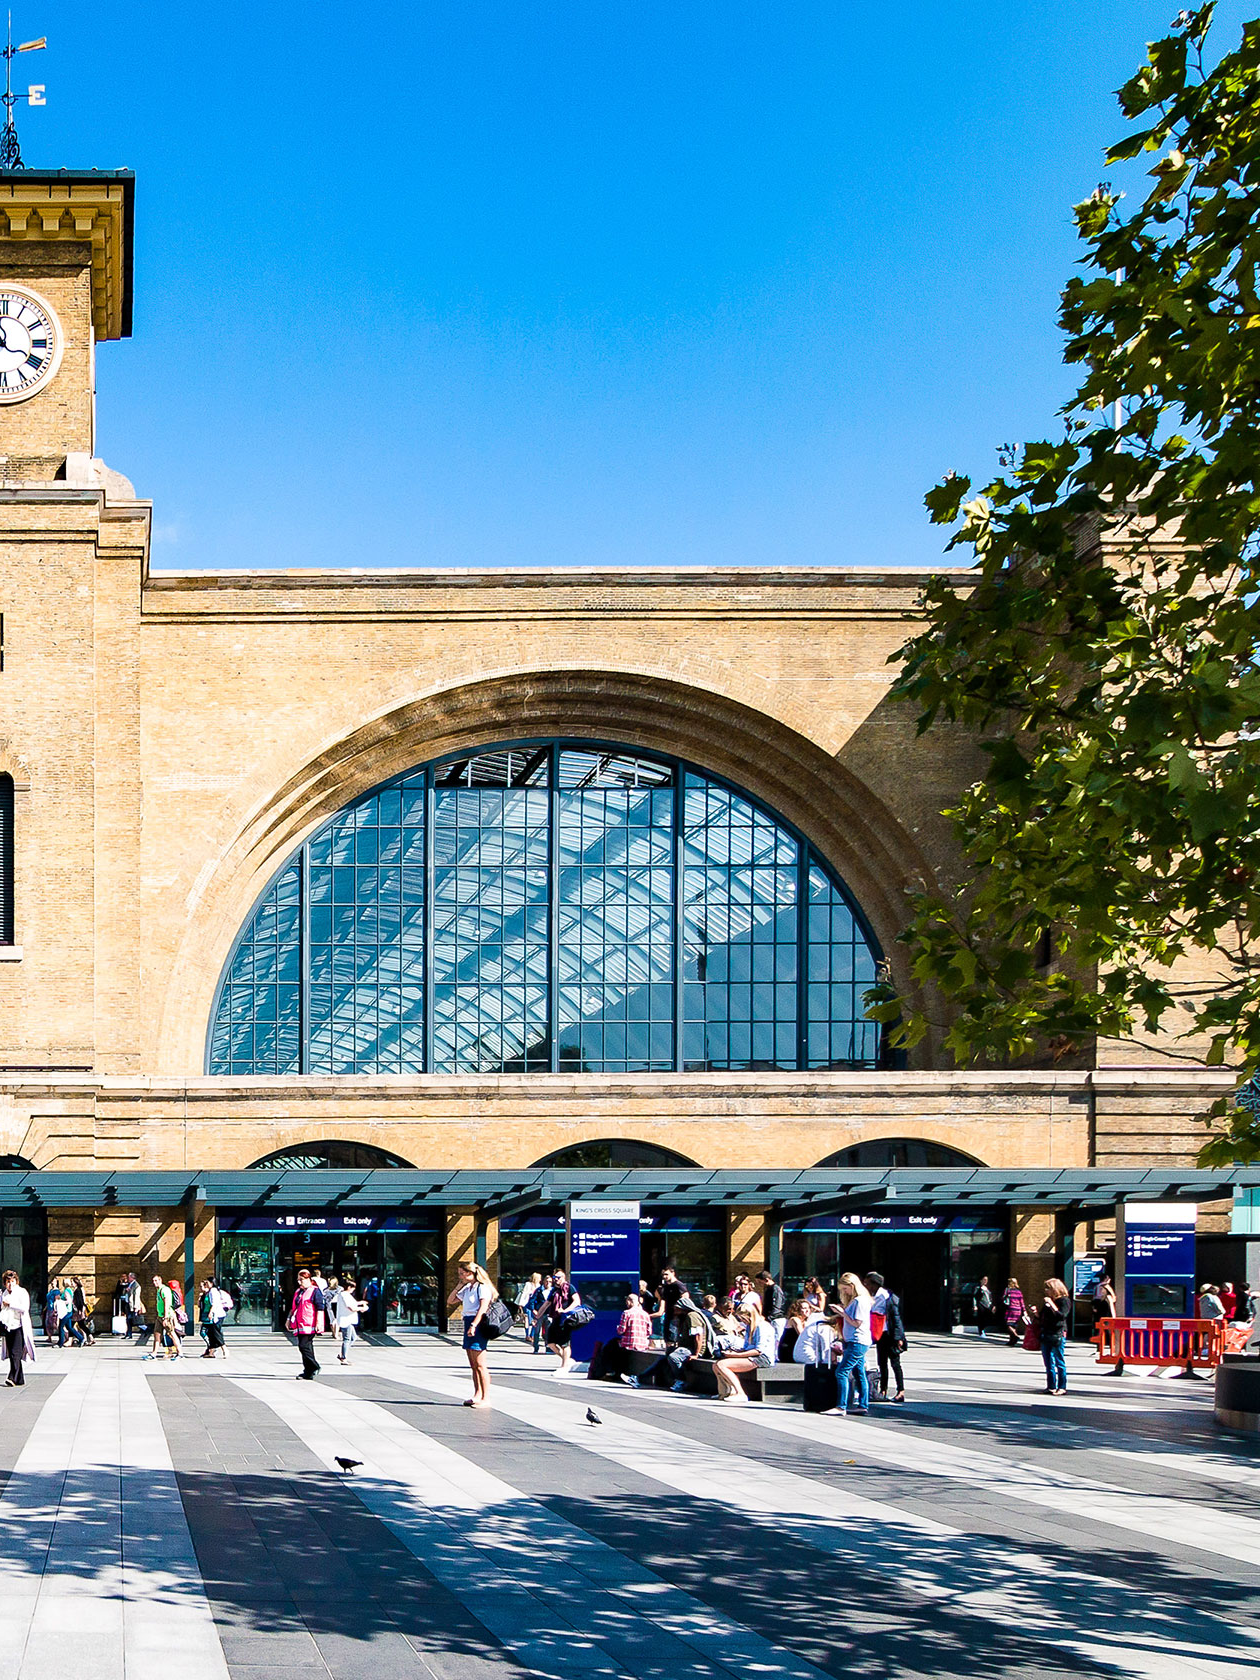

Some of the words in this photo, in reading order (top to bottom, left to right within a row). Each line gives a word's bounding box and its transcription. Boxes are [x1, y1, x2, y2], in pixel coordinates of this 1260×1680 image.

[28, 84, 46, 106] E
[31, 339, 48, 348] III
[357, 1217, 373, 1225] only
[639, 1216, 654, 1225] only
[861, 1216, 891, 1224] Entrance
[908, 1216, 922, 1224] Exit
[922, 1216, 938, 1225] only
[303, 1232, 311, 1243] 3
